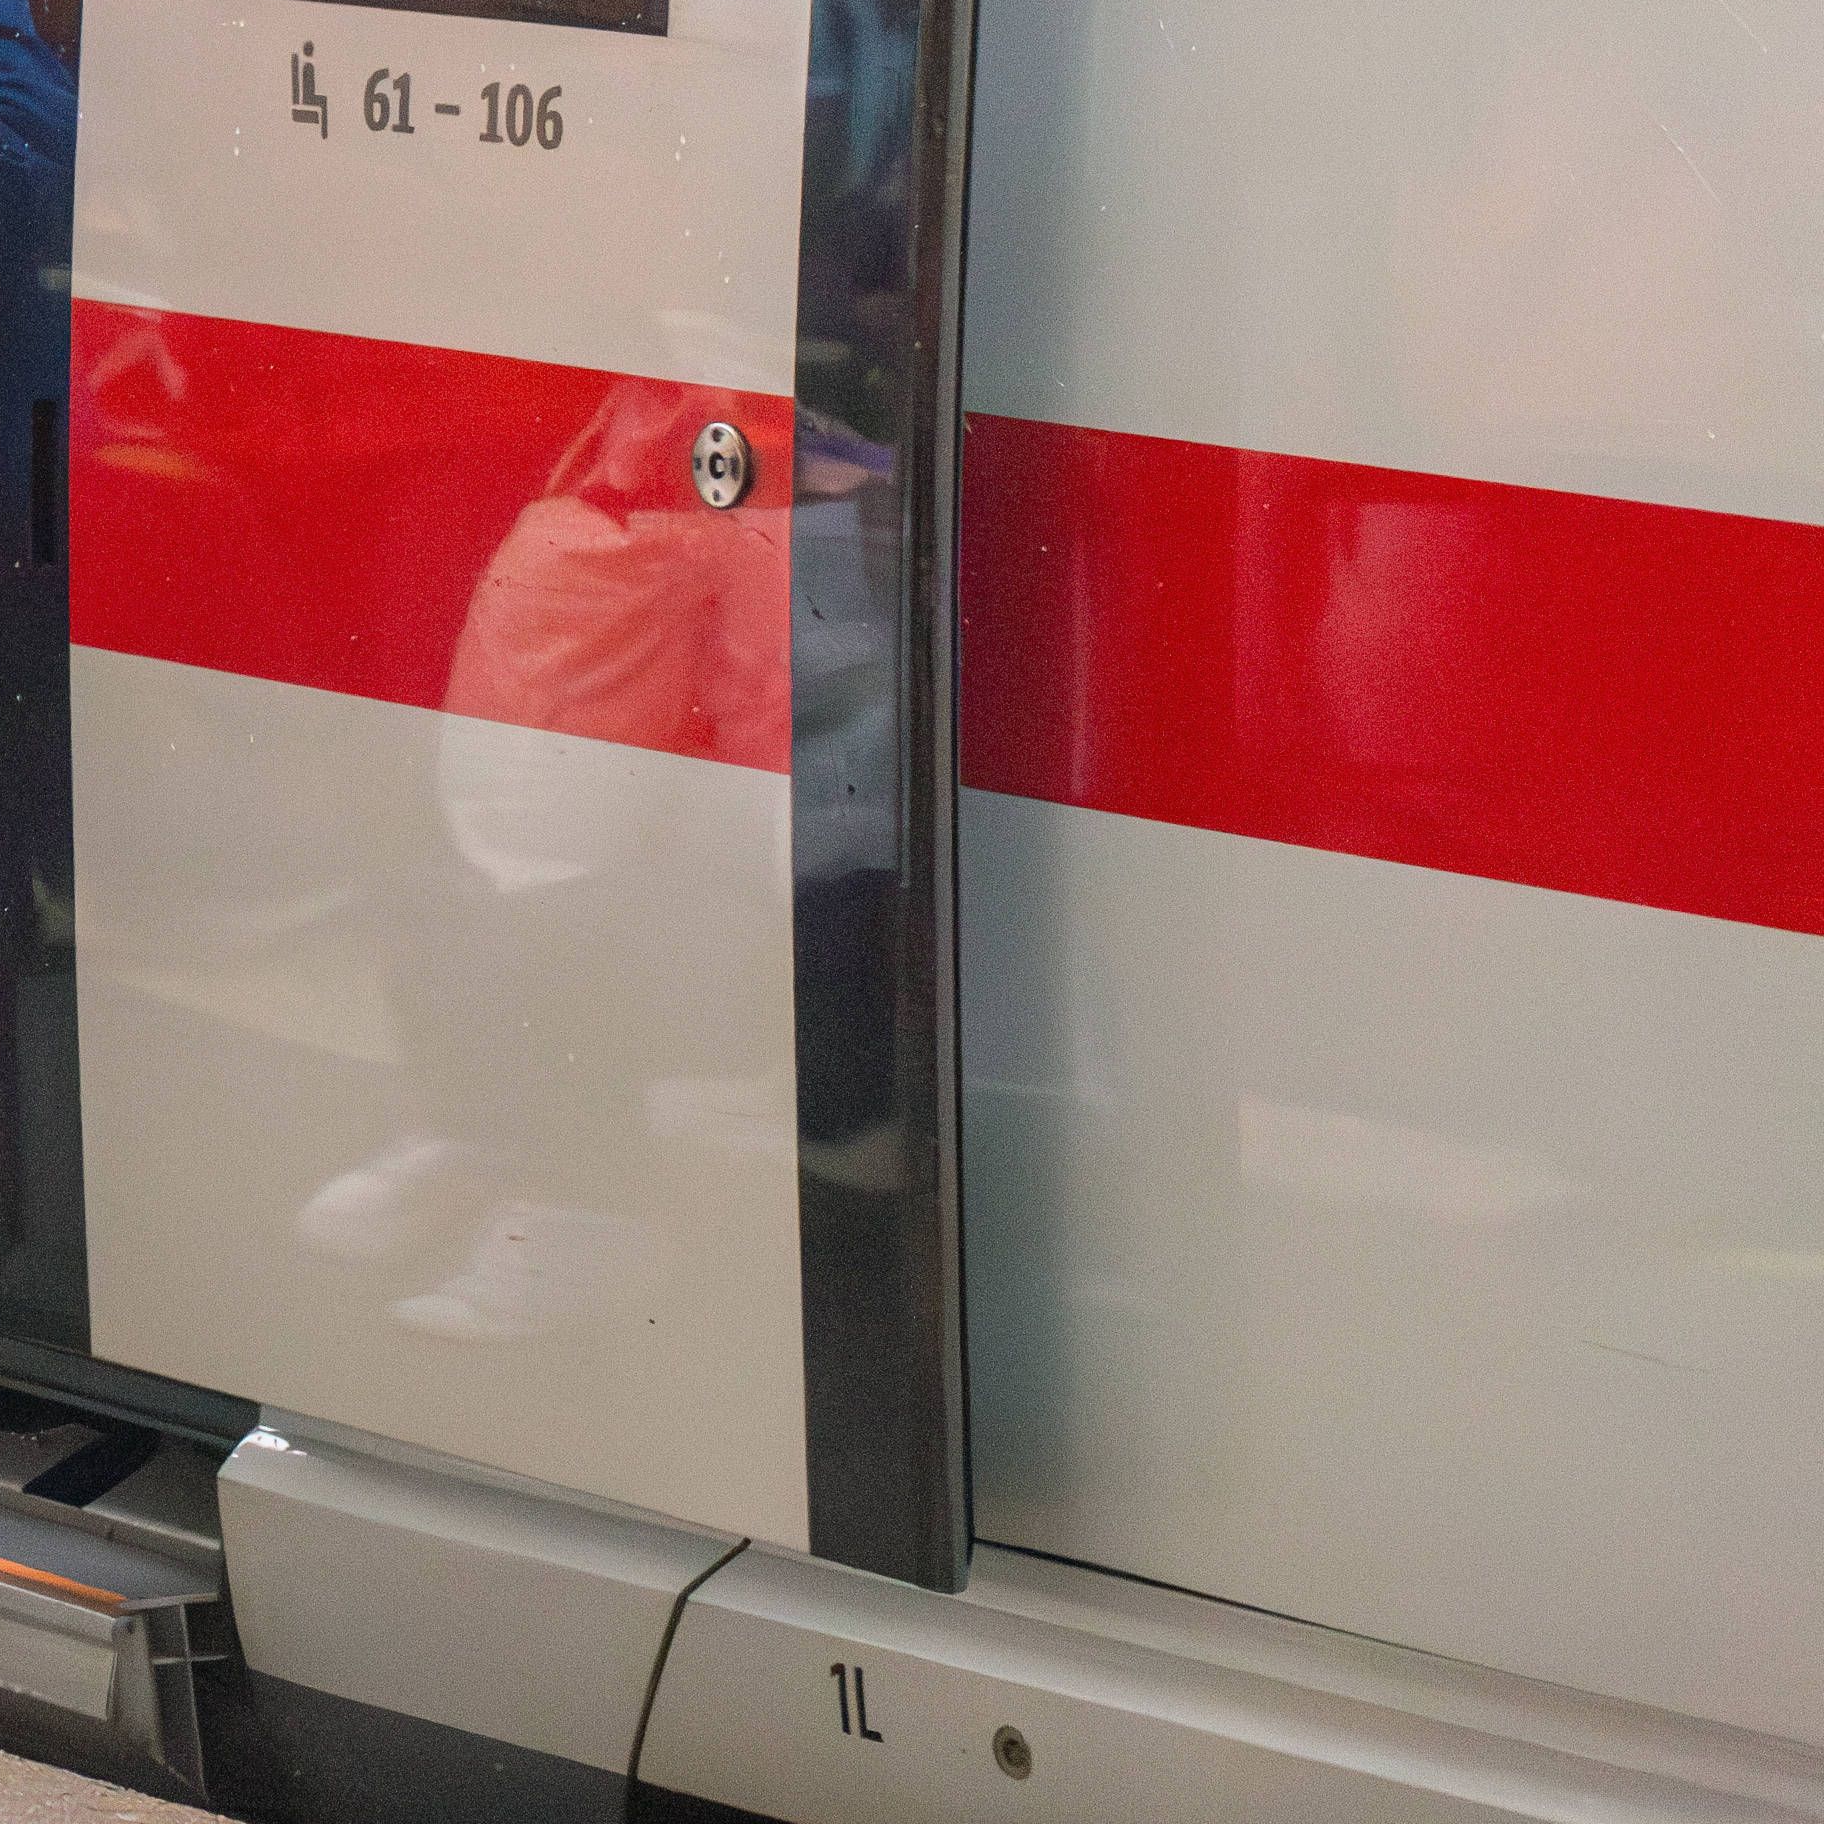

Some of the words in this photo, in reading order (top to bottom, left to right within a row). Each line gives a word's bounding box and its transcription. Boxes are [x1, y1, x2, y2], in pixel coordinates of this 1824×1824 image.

[363, 68, 414, 133] 61
[479, 81, 563, 150] 106
[829, 1662, 885, 1743] 1L
